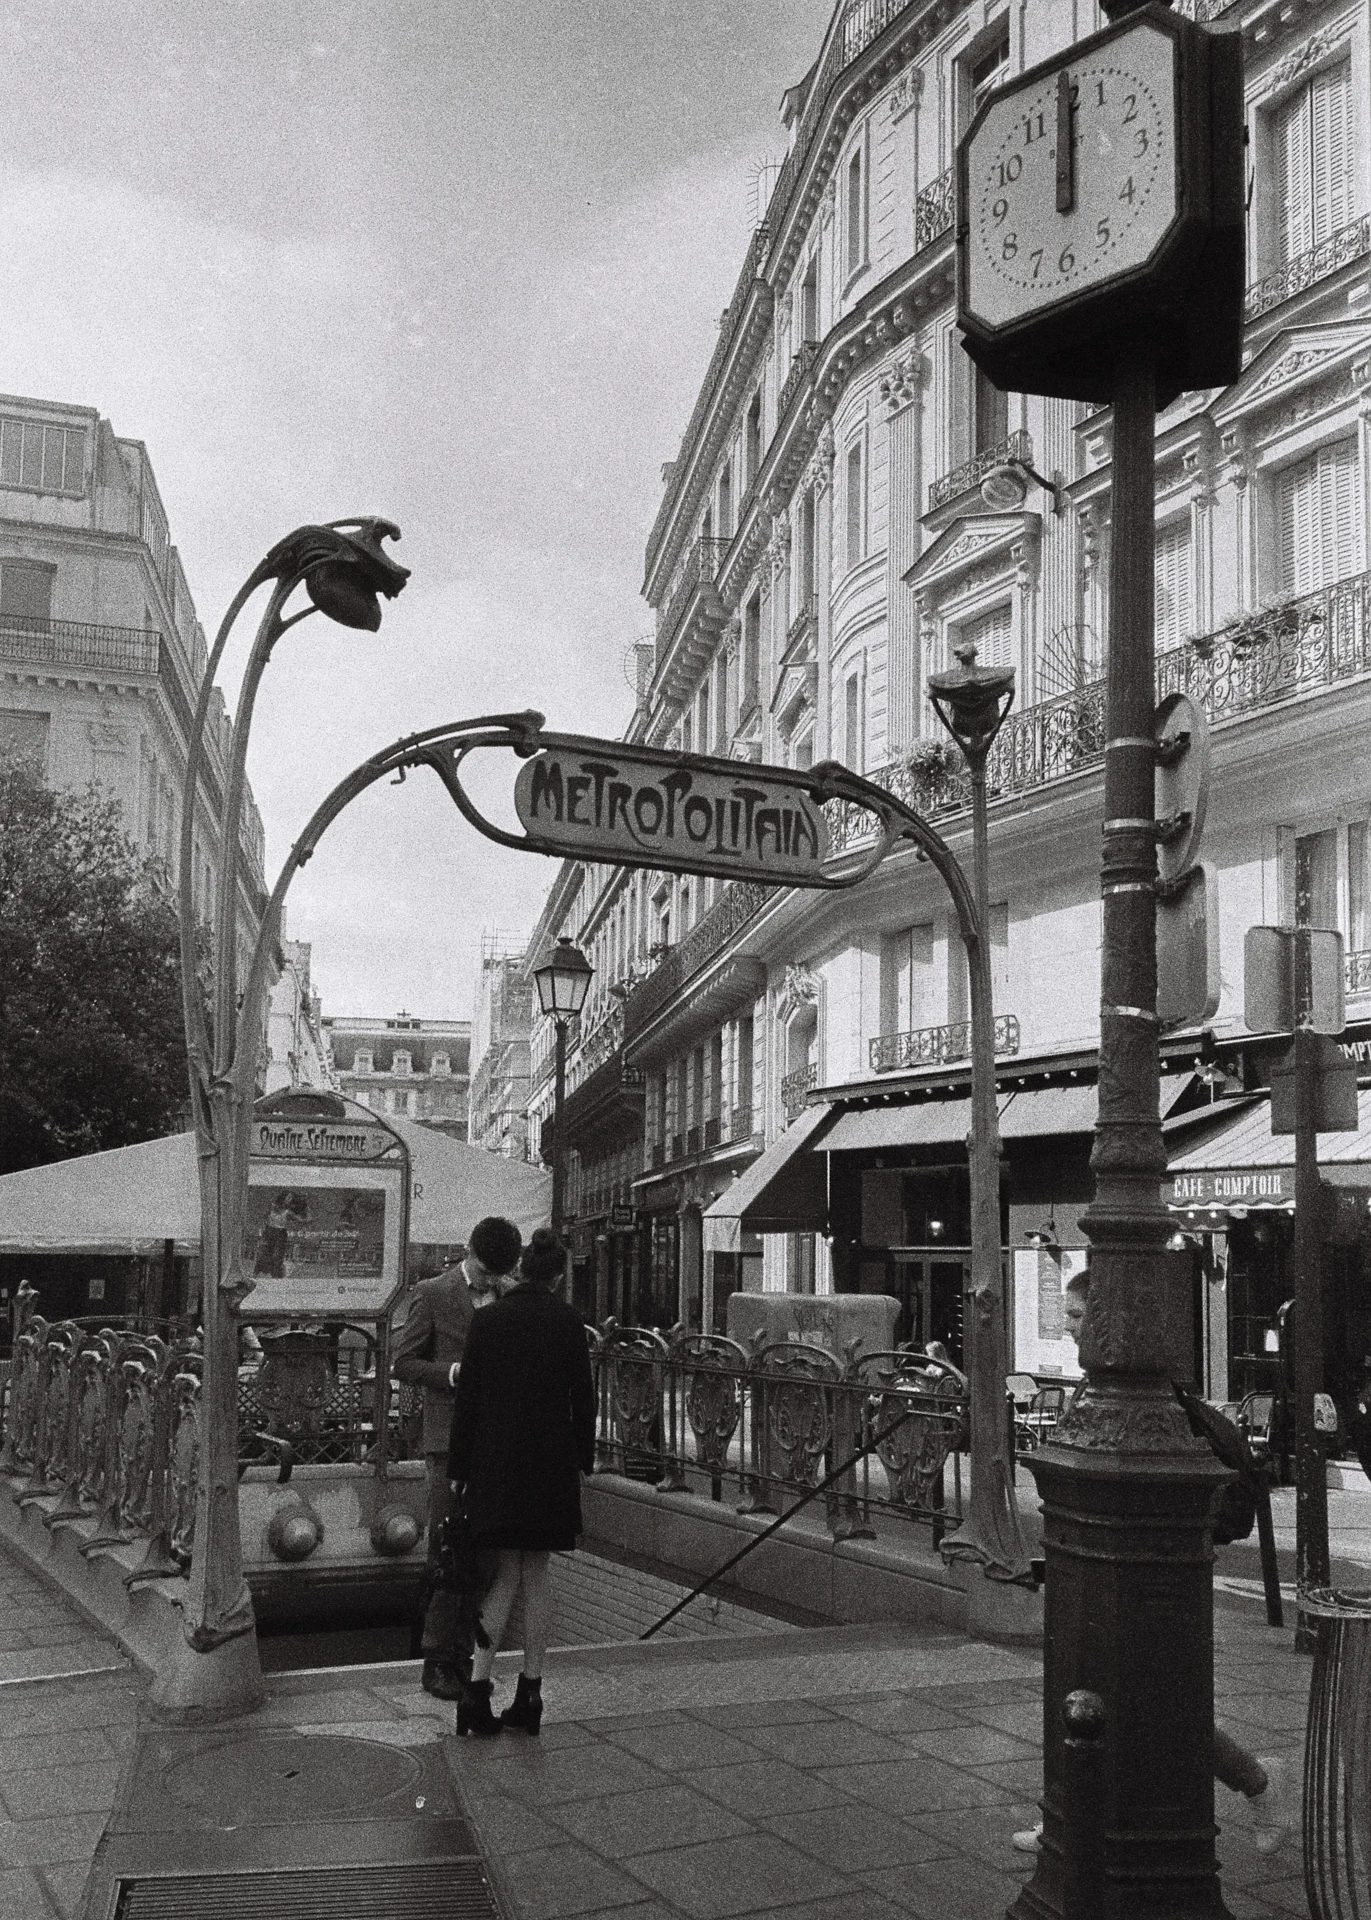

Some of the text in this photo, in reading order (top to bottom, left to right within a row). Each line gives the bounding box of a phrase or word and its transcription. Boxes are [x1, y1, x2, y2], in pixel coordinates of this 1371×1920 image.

[1094, 80, 1108, 108] 1
[1121, 94, 1139, 124] 2
[1023, 112, 1047, 146] 11
[1133, 128, 1149, 159] 3
[996, 154, 1023, 188] 10
[1118, 176, 1137, 205] 4
[992, 199, 1009, 228] 9
[1002, 232, 1018, 261] 8
[1095, 217, 1110, 249] 5
[1029, 249, 1044, 278] 7
[1058, 243, 1075, 273] 6
[414, 1182, 424, 1200] R
[1173, 1177, 1204, 1198] CAFE
[1214, 1174, 1282, 1197] COMPTOIR
